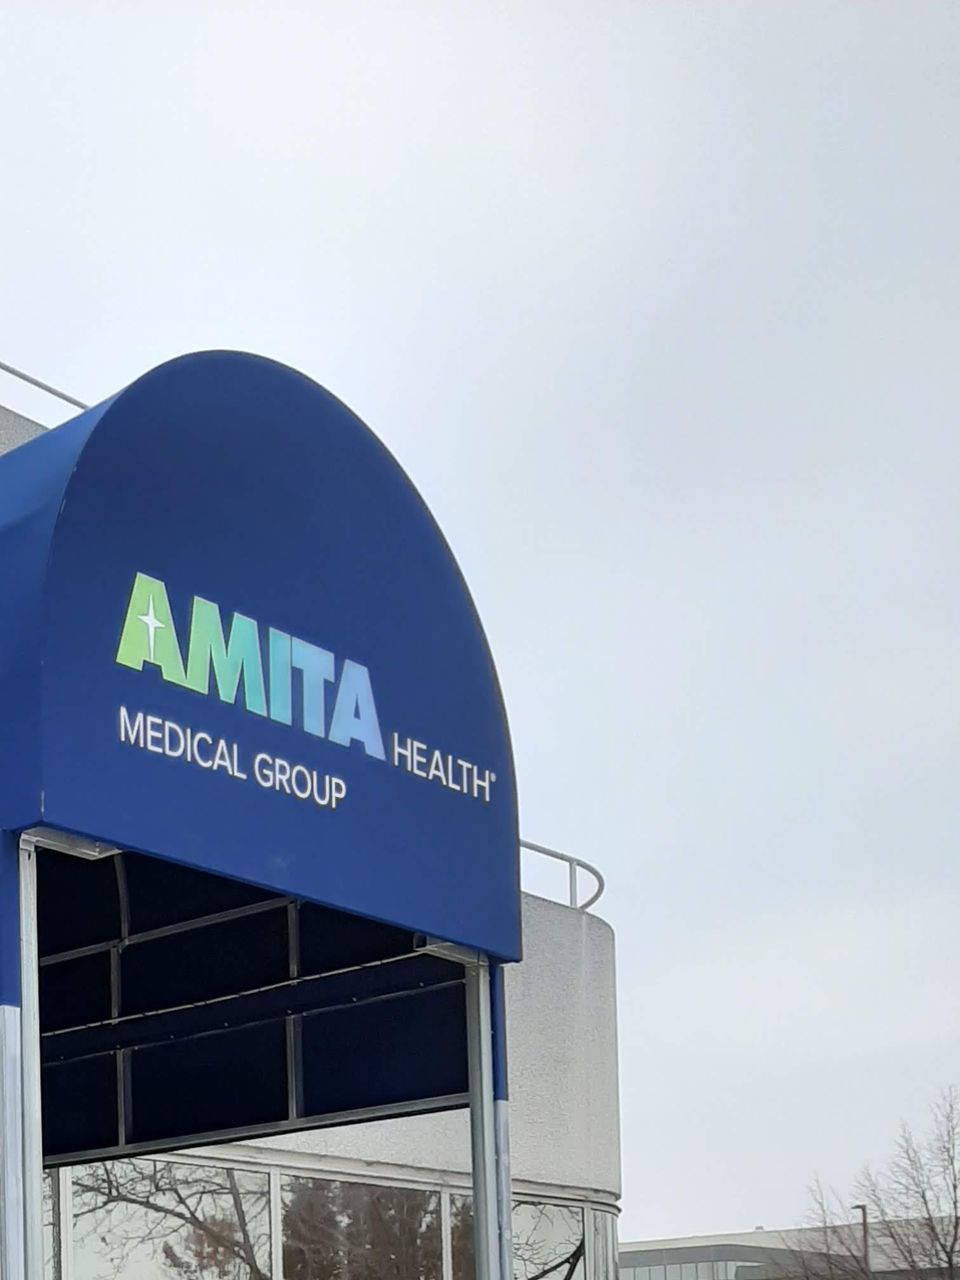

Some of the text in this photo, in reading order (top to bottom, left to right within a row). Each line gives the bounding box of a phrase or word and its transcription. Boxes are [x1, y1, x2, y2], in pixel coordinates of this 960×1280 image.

[115, 571, 387, 762] AMITA
[120, 706, 347, 809] MEDICAL GROUP
